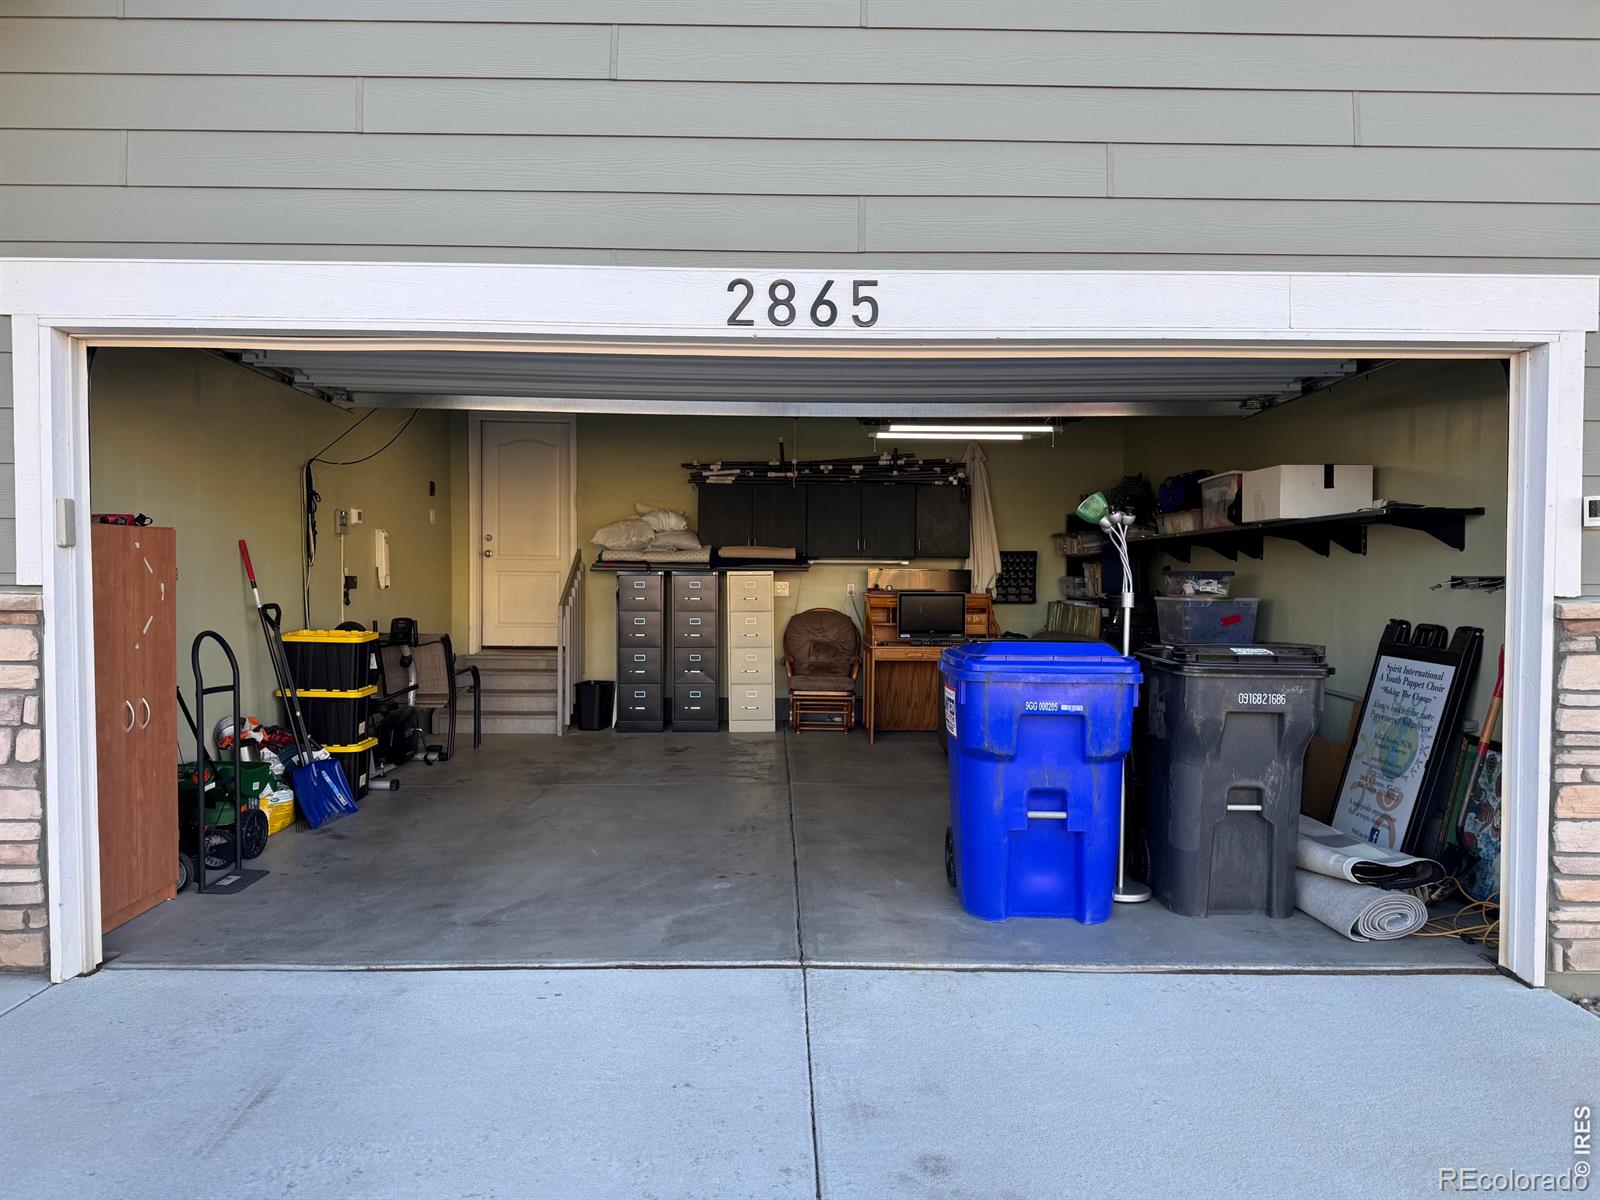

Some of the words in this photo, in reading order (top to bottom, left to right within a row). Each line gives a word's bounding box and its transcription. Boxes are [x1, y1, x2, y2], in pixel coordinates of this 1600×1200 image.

[727, 278, 879, 327] 2865
[1386, 663, 1402, 674] Spirit
[1403, 666, 1444, 681] International
[1386, 674, 1402, 685] Youth
[1402, 678, 1425, 690] Puppet
[1426, 681, 1445, 693] Choir
